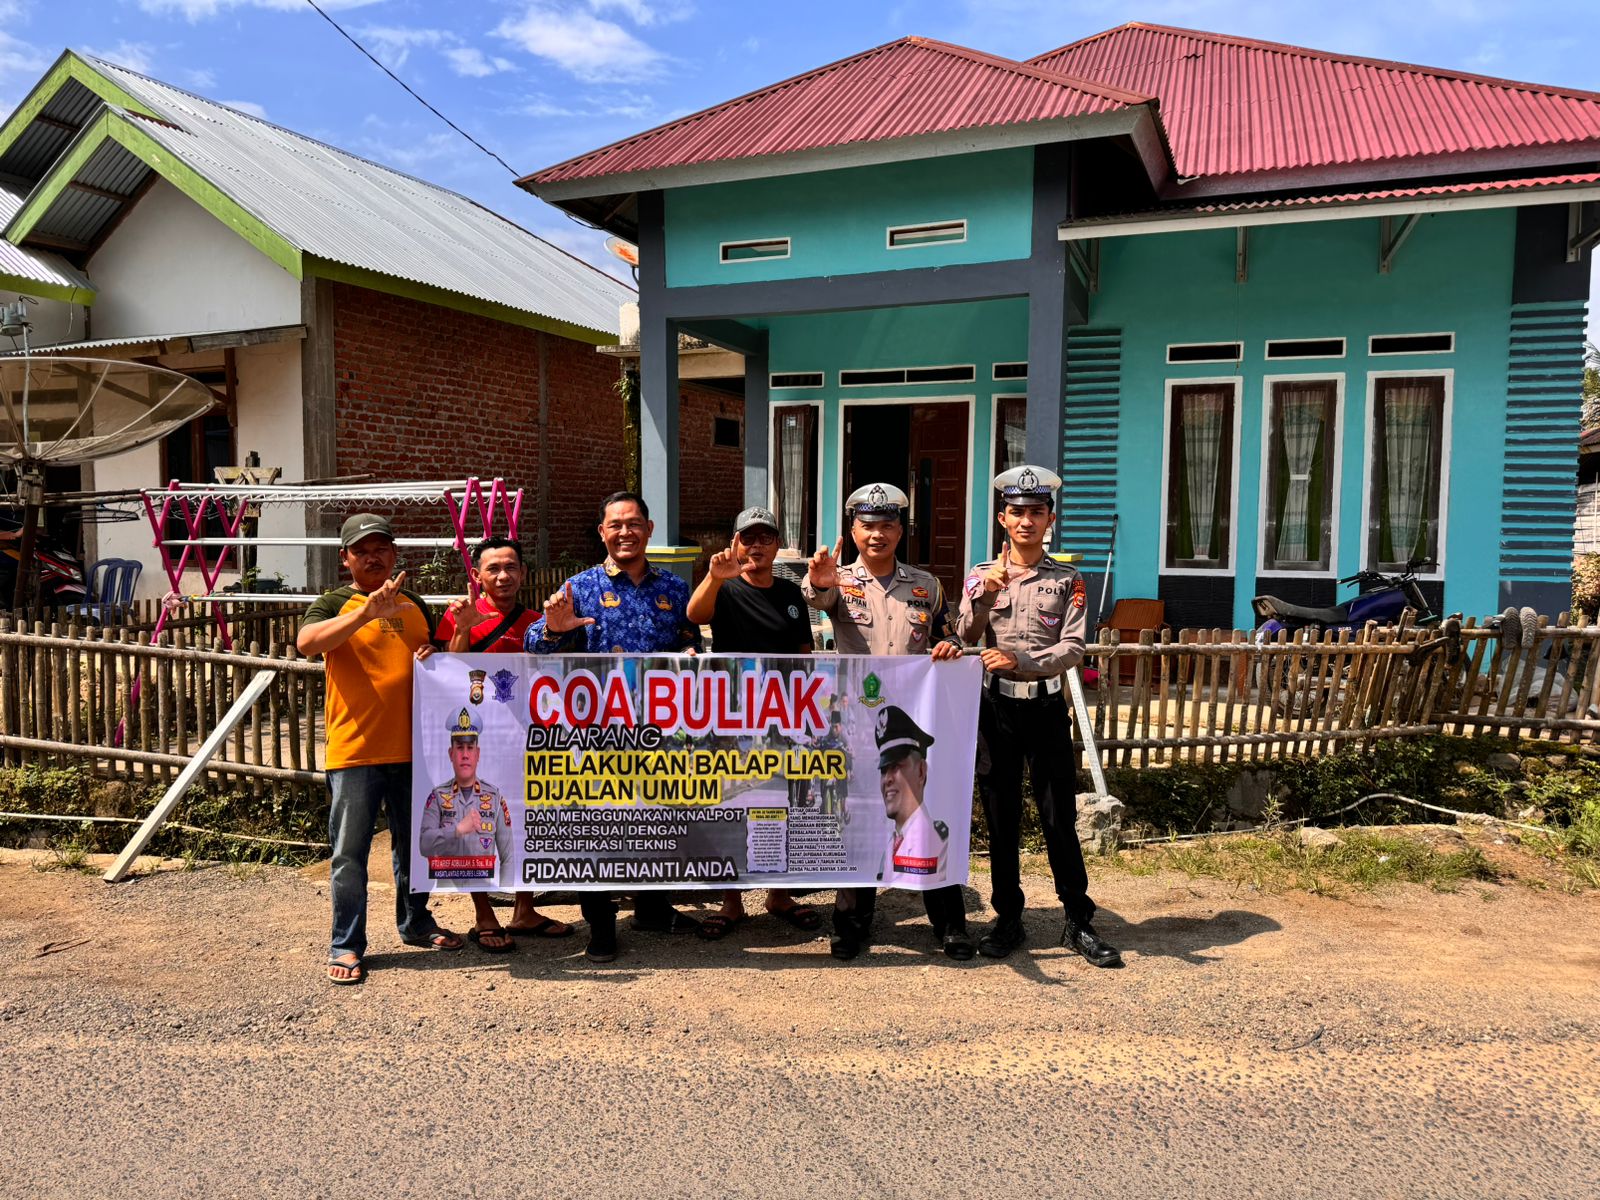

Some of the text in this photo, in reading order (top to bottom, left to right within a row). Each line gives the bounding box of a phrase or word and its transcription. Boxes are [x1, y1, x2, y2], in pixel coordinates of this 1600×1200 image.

[1037, 586, 1065, 597] POLR
[529, 675, 825, 730] COA BULIAK
[528, 727, 661, 749] DILARANG
[527, 754, 843, 776] MELAKUKAN BALAP LIAR
[527, 778, 718, 801] DIJALAN UMUM
[526, 811, 556, 822] DAN
[560, 810, 676, 822] MENGGUNAKAN
[676, 809, 743, 822] KNALPOT
[526, 825, 688, 837] TIDAK SESUAI DENGAN
[526, 839, 677, 851] SPEKSIFIKASI TEKNIS
[525, 861, 736, 879] PIDANA MENANTI ANDA
